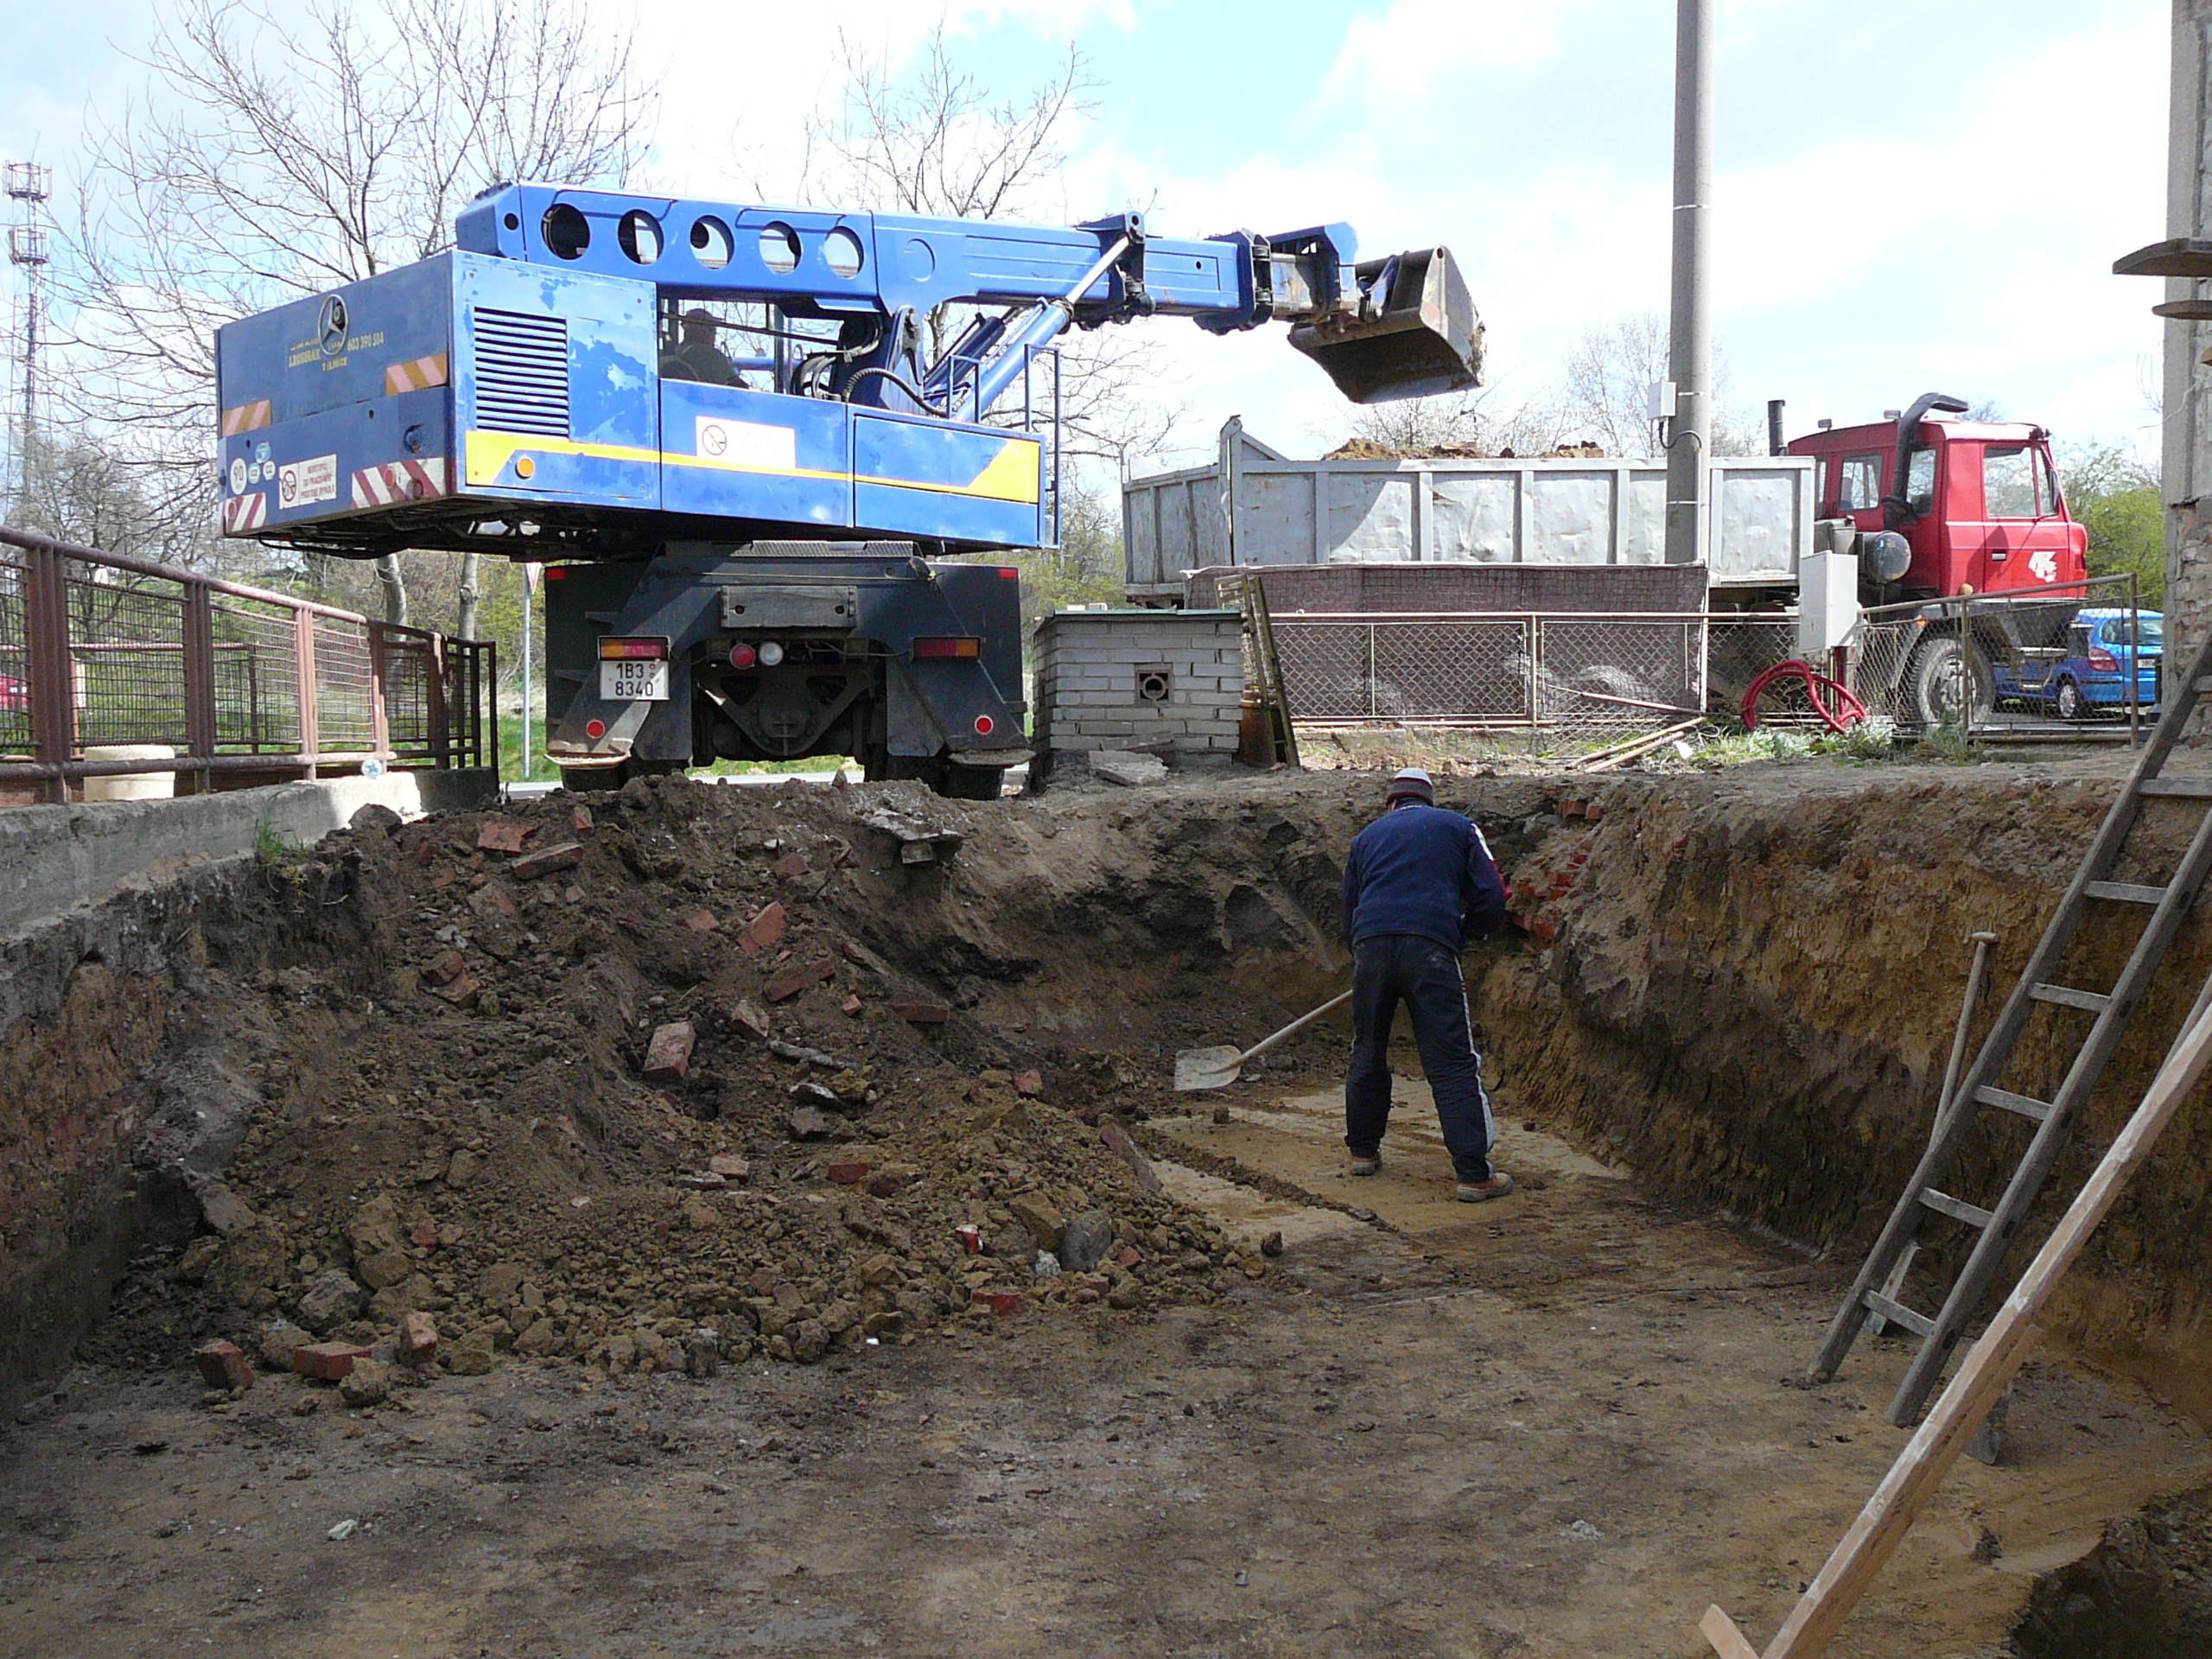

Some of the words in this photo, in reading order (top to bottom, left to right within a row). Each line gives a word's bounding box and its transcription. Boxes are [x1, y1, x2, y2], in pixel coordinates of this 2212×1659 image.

[233, 465, 244, 481] 90
[616, 663, 644, 679] 1B3
[615, 681, 653, 697] 8340
